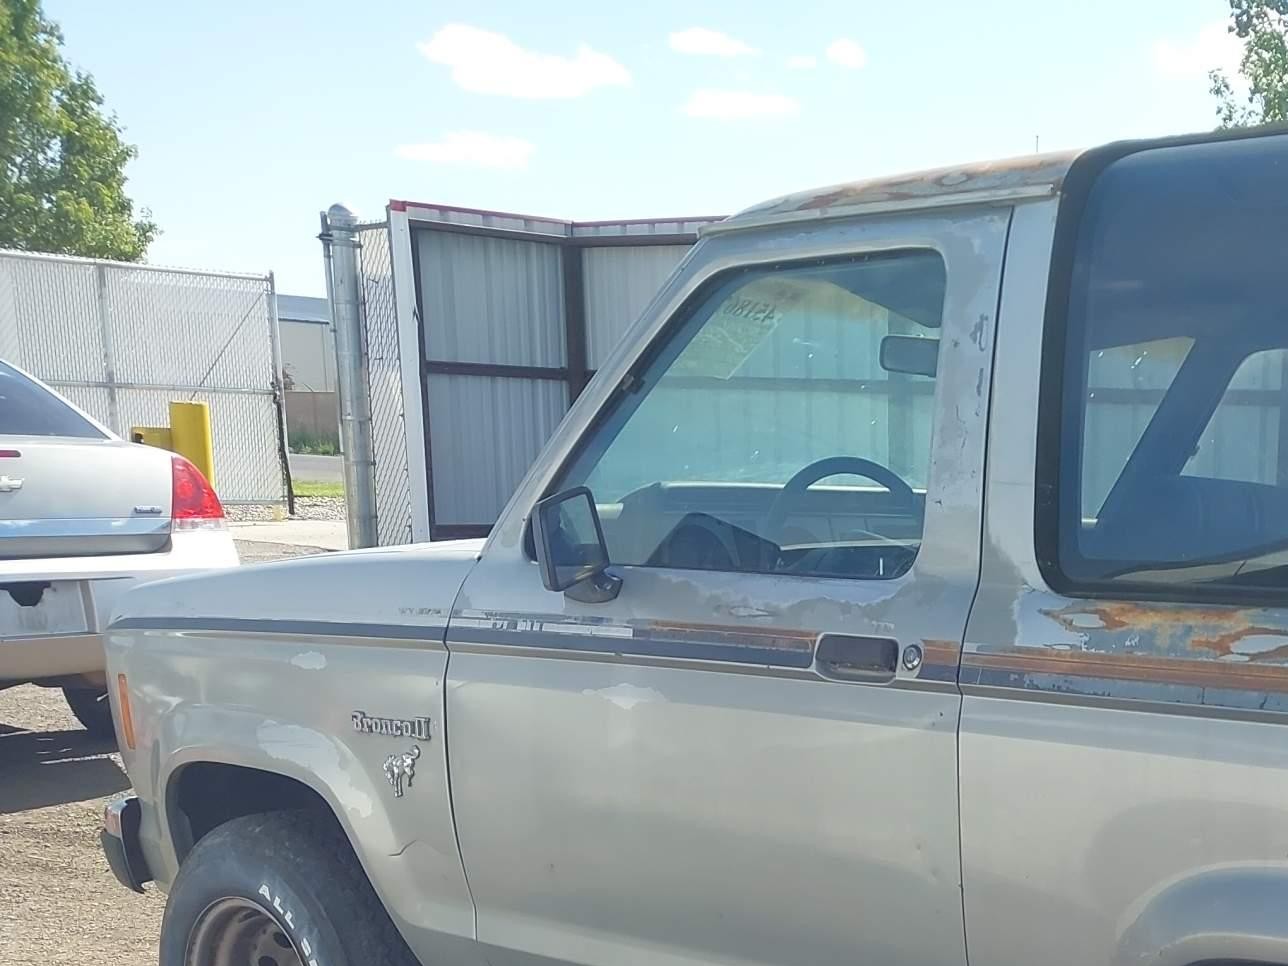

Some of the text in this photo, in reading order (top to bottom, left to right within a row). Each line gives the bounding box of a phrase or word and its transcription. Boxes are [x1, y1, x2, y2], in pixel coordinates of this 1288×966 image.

[352, 710, 431, 741] Bronco II
[258, 883, 296, 930] ALL
